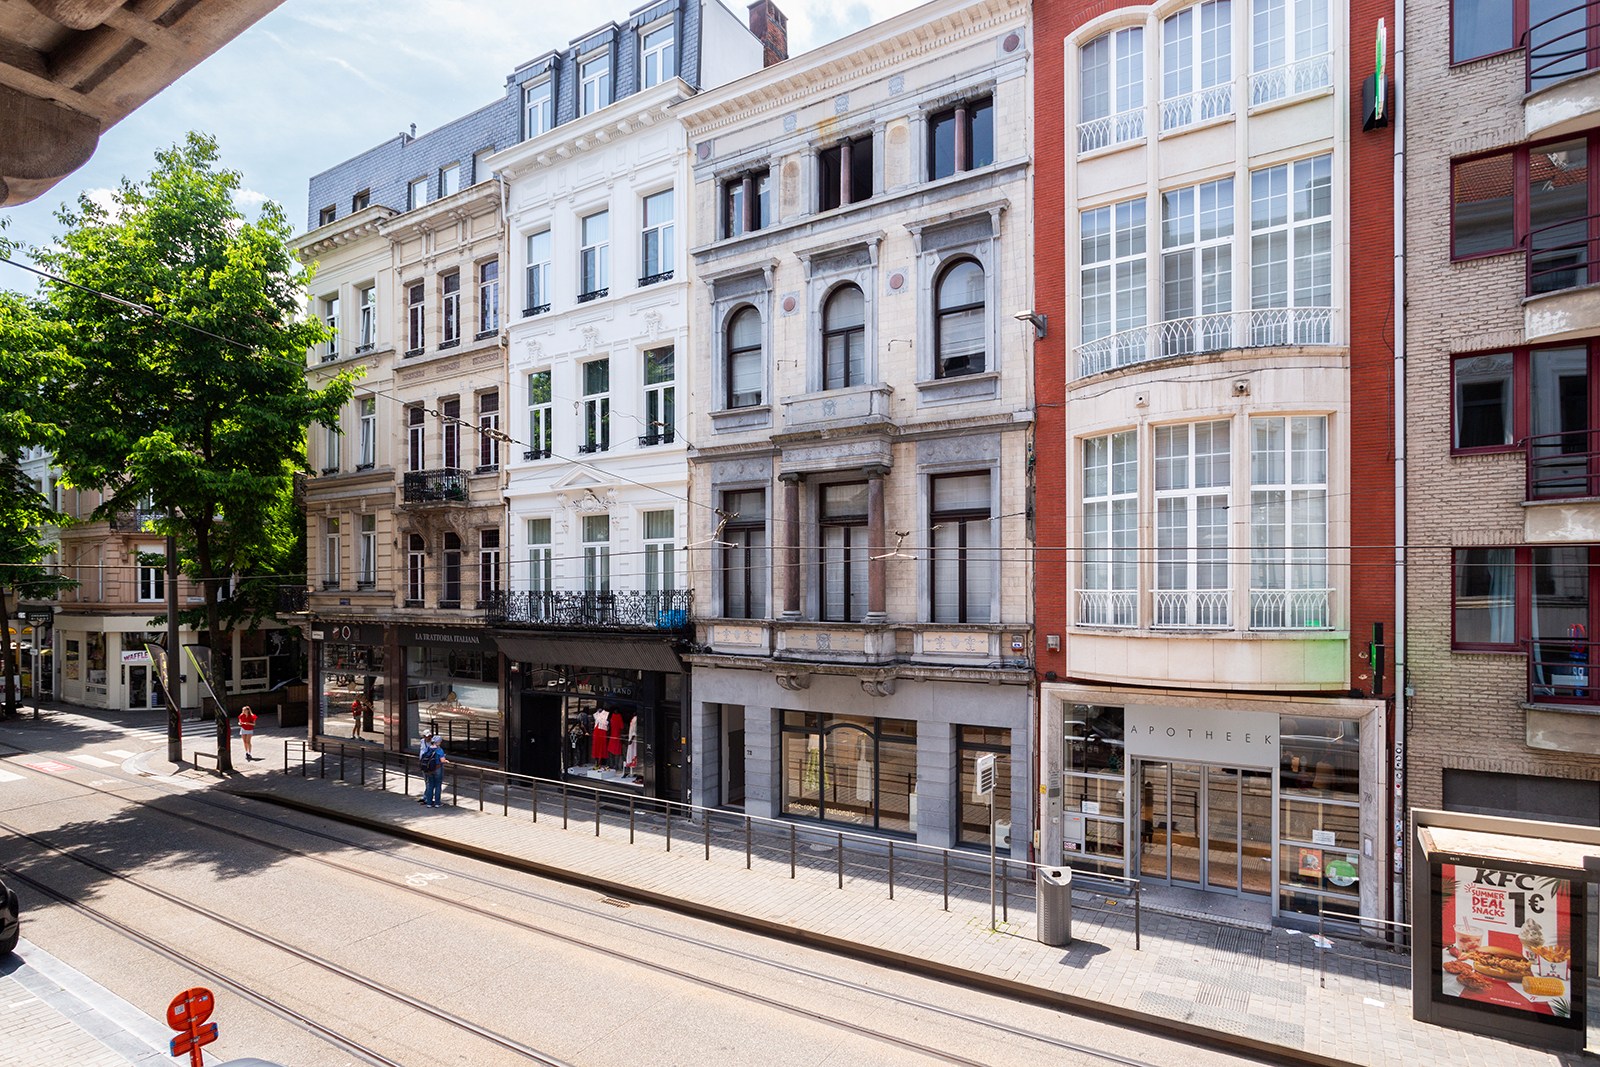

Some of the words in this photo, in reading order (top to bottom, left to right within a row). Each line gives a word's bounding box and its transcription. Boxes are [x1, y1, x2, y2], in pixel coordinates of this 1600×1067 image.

[423, 633, 453, 642] TRATTORIA
[454, 635, 480, 644] ITALIANA
[1130, 725, 1272, 744] APOTHEEK
[826, 807, 856, 818] nationale
[1473, 868, 1536, 891] KFC
[1472, 889, 1505, 900] SUMMER
[1472, 896, 1505, 910] DEAL
[1472, 906, 1505, 918] SNACKS
